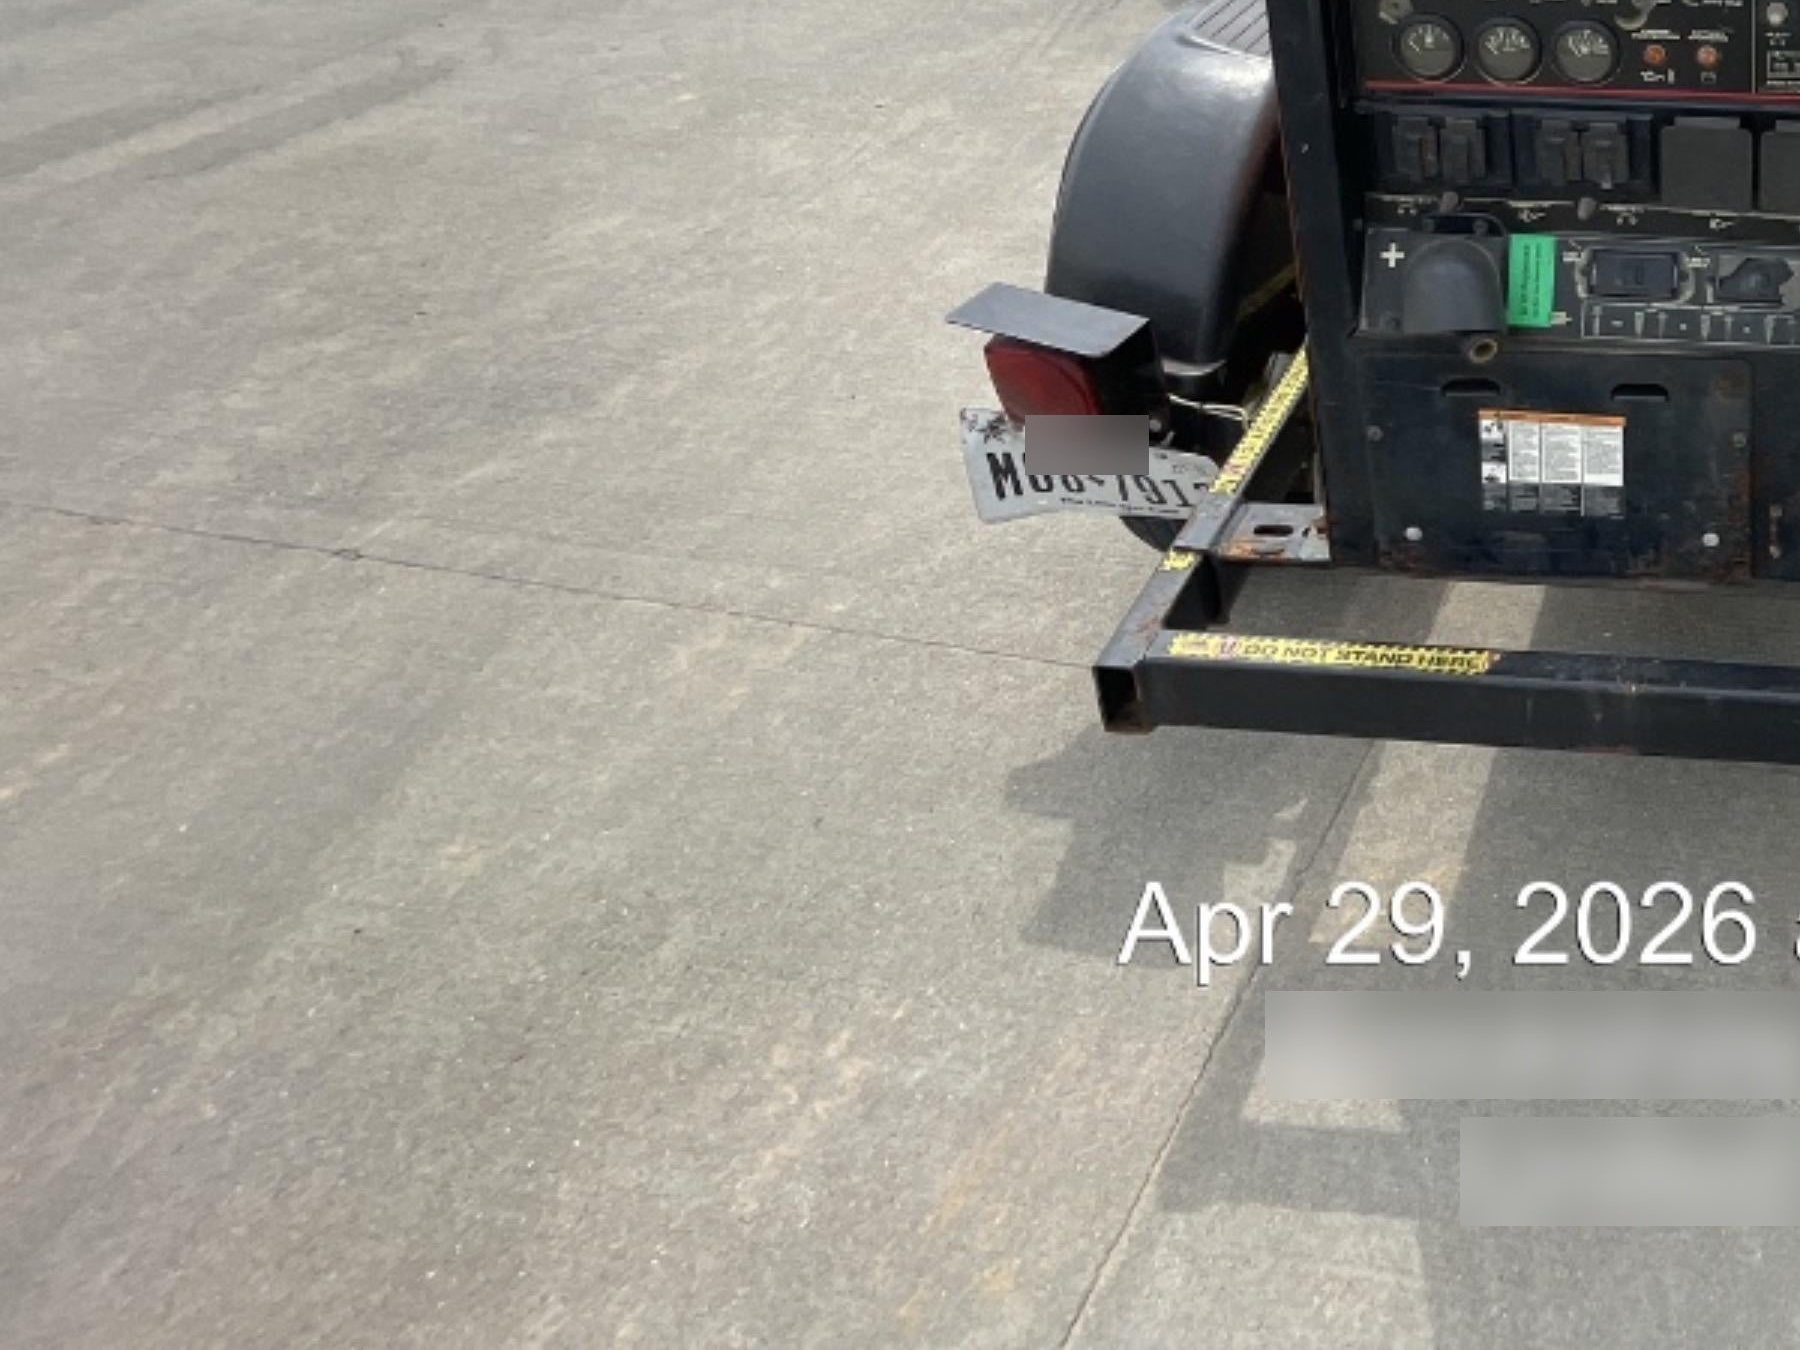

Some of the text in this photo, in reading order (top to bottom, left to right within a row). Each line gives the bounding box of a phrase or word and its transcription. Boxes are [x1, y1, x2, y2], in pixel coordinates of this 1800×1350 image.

[1243, 643, 1278, 656] DO
[1282, 646, 1328, 660] NOT
[1335, 649, 1413, 666] STAND
